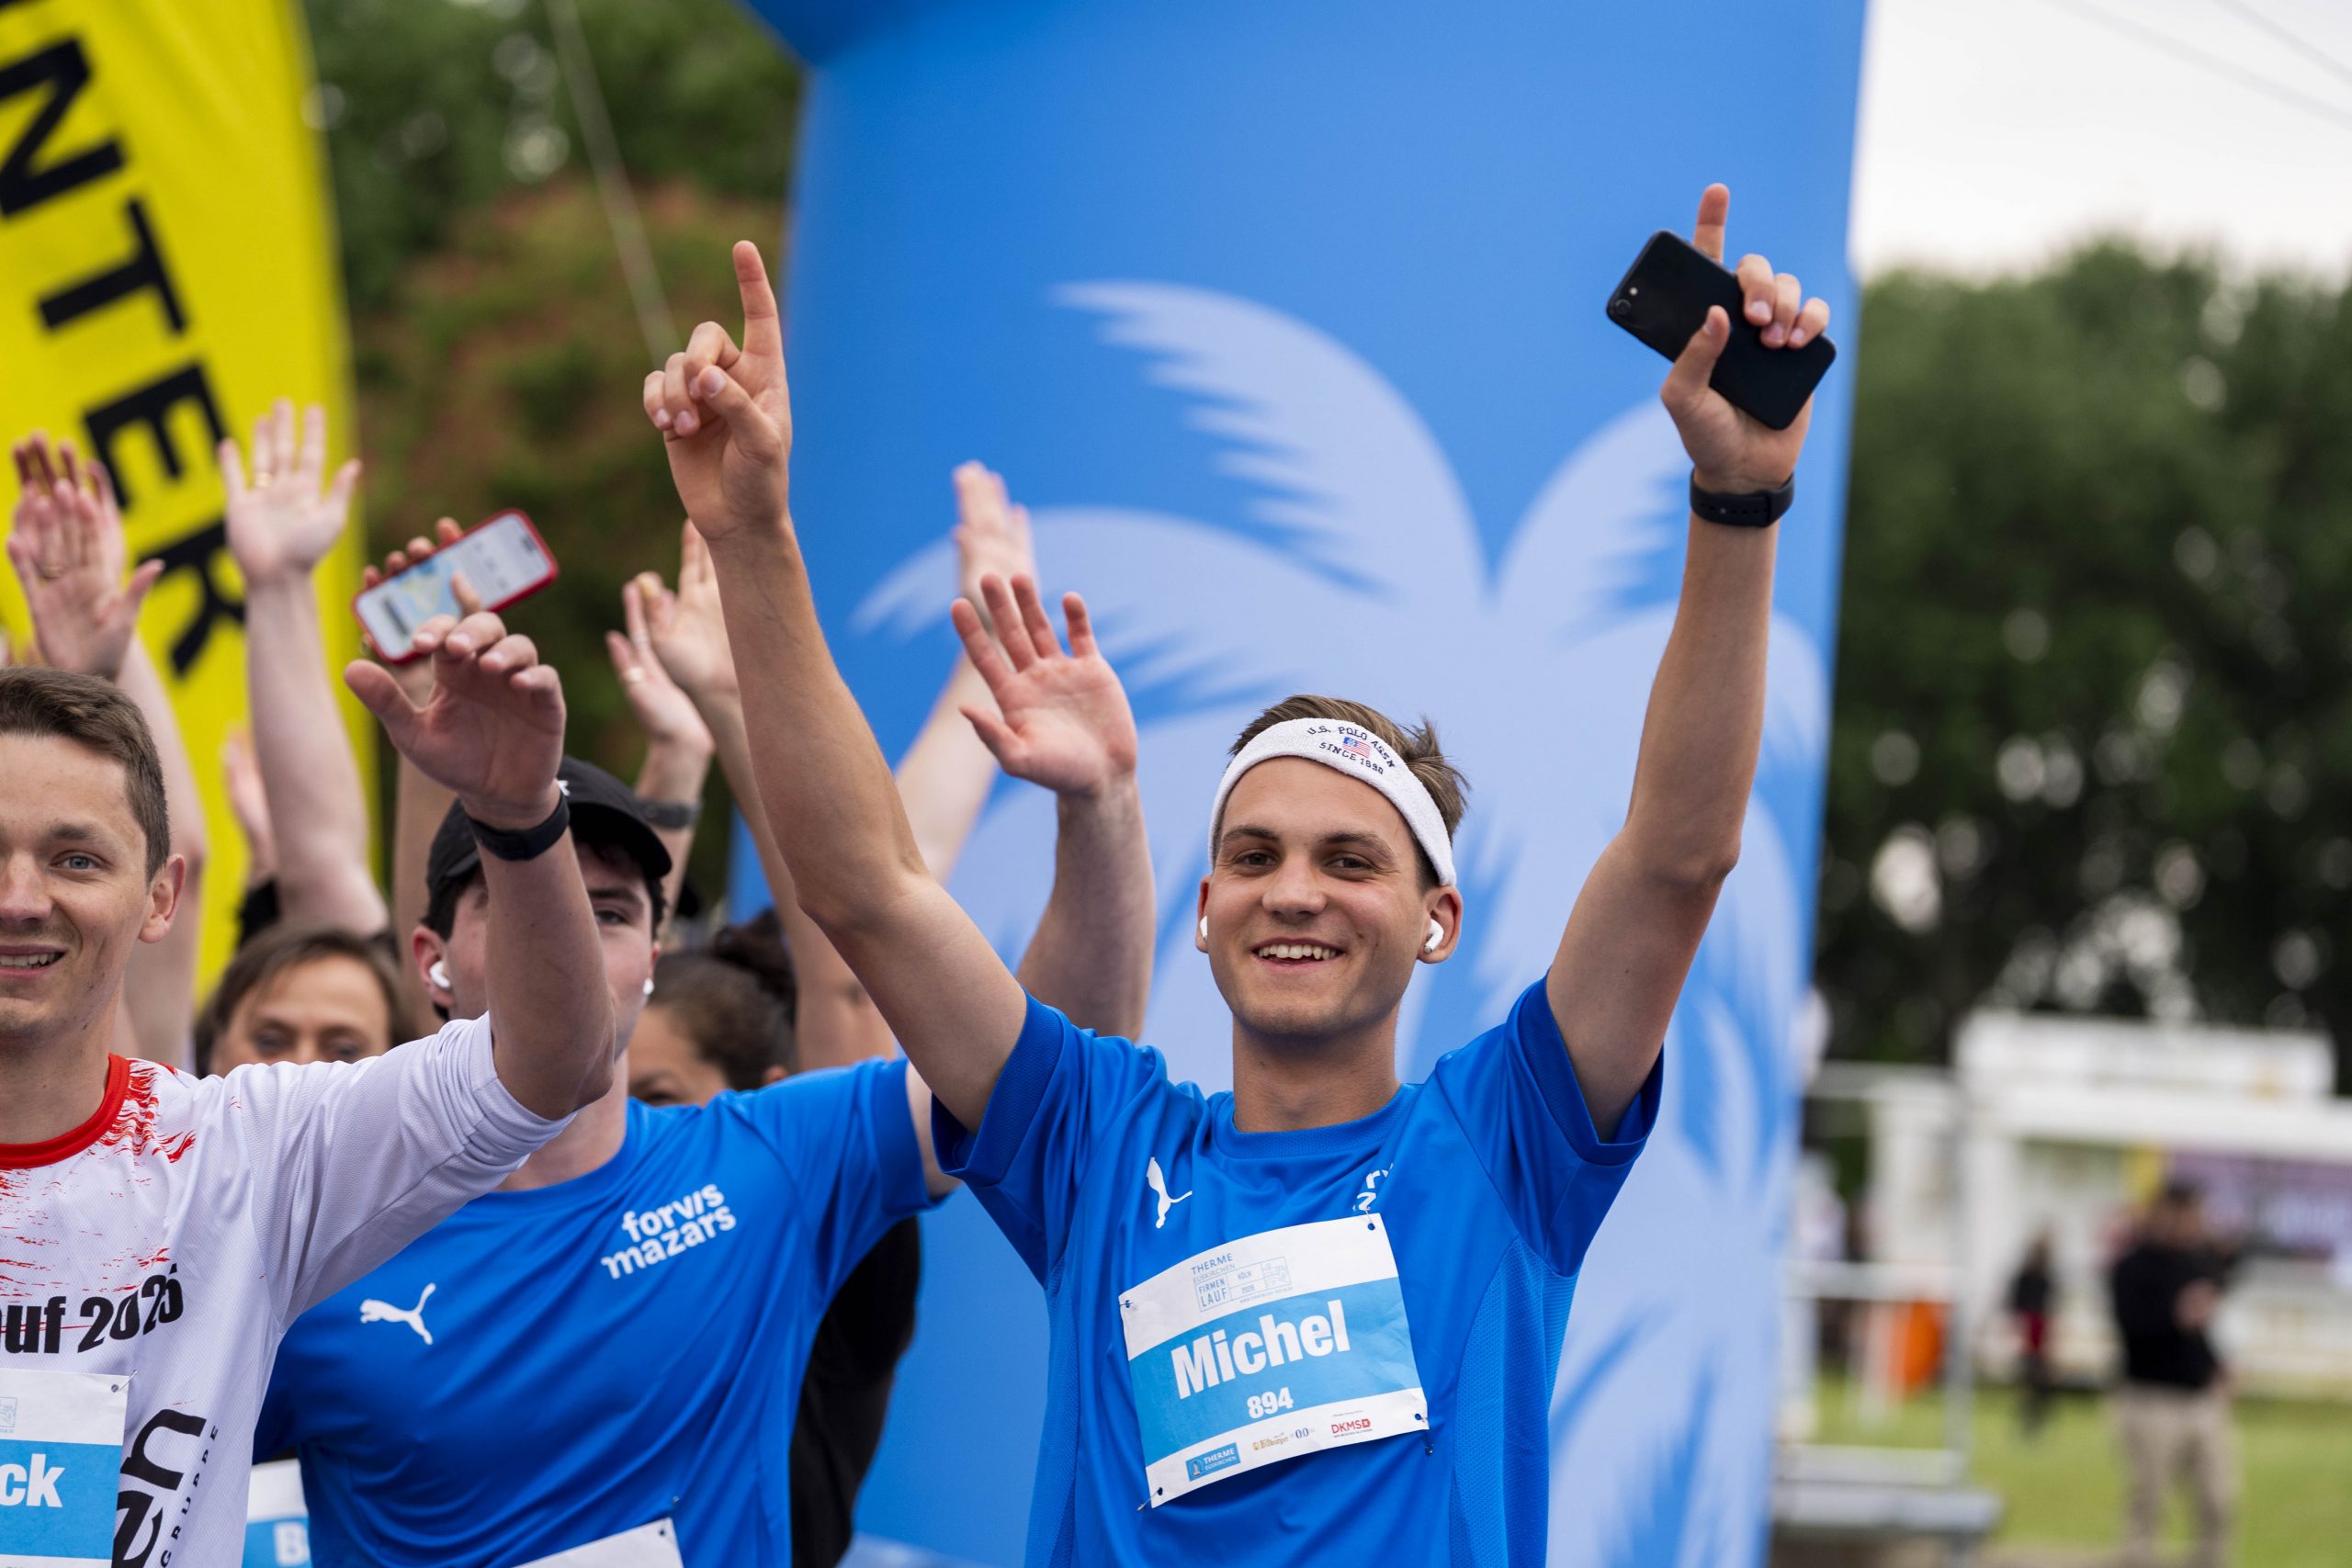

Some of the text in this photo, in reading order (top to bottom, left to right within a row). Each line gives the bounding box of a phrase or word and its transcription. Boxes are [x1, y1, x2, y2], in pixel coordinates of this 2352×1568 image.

[0, 0, 248, 678] NTER
[1338, 727, 1367, 740] POLO
[1319, 742, 1384, 774] SINCE 1890
[621, 1184, 725, 1243] forvis
[600, 1205, 737, 1280] mazars
[1191, 1253, 1233, 1274] THERME
[1199, 1278, 1225, 1294] FIRMEN
[1201, 1288, 1227, 1307] LAUF
[0, 1296, 66, 1354] uf
[1170, 1299, 1351, 1399] Michel
[1247, 1387, 1294, 1419] 894
[1331, 1420, 1361, 1434] DKMS
[1204, 1449, 1236, 1464] THERME
[160, 1426, 219, 1568] GRUPPE
